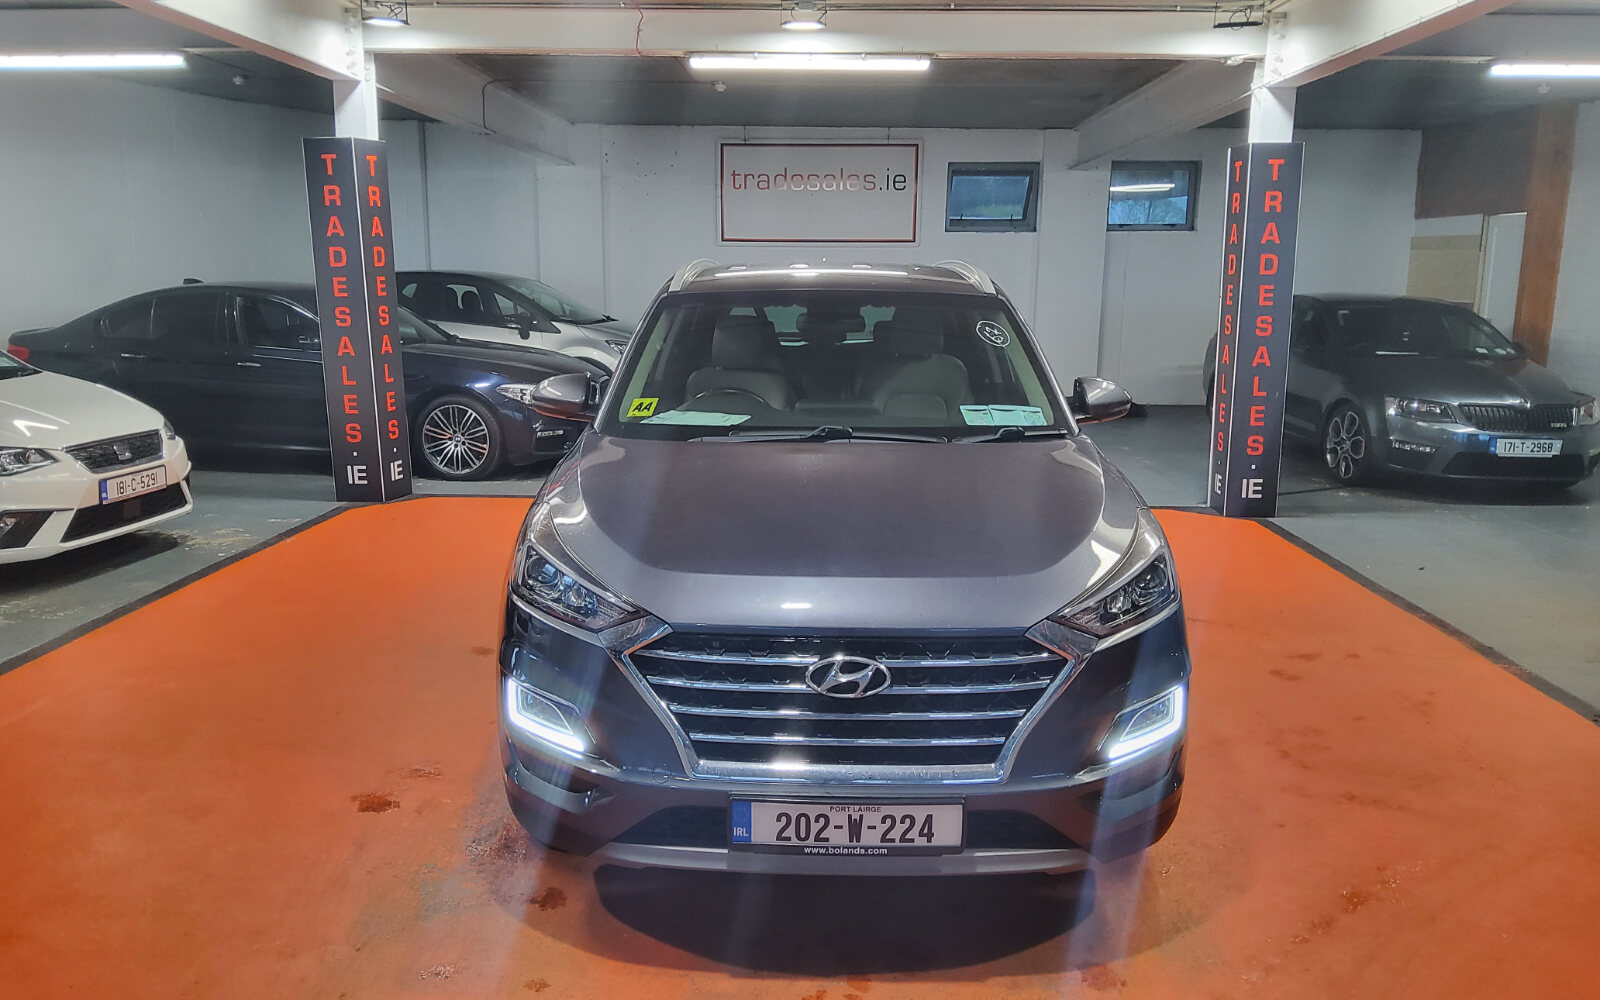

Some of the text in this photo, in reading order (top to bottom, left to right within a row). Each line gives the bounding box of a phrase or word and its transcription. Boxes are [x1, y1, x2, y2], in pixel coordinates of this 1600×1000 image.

[730, 167, 907, 191] tradesales.ie
[631, 401, 654, 412] AA
[1503, 441, 1554, 453] 171-T-2968
[116, 471, 158, 496] 181-C-5291
[829, 805, 882, 814] PORT LAIRGE
[733, 826, 749, 837] IRL
[775, 811, 935, 844] 202-W-224
[803, 845, 888, 855] www.bolands.com
